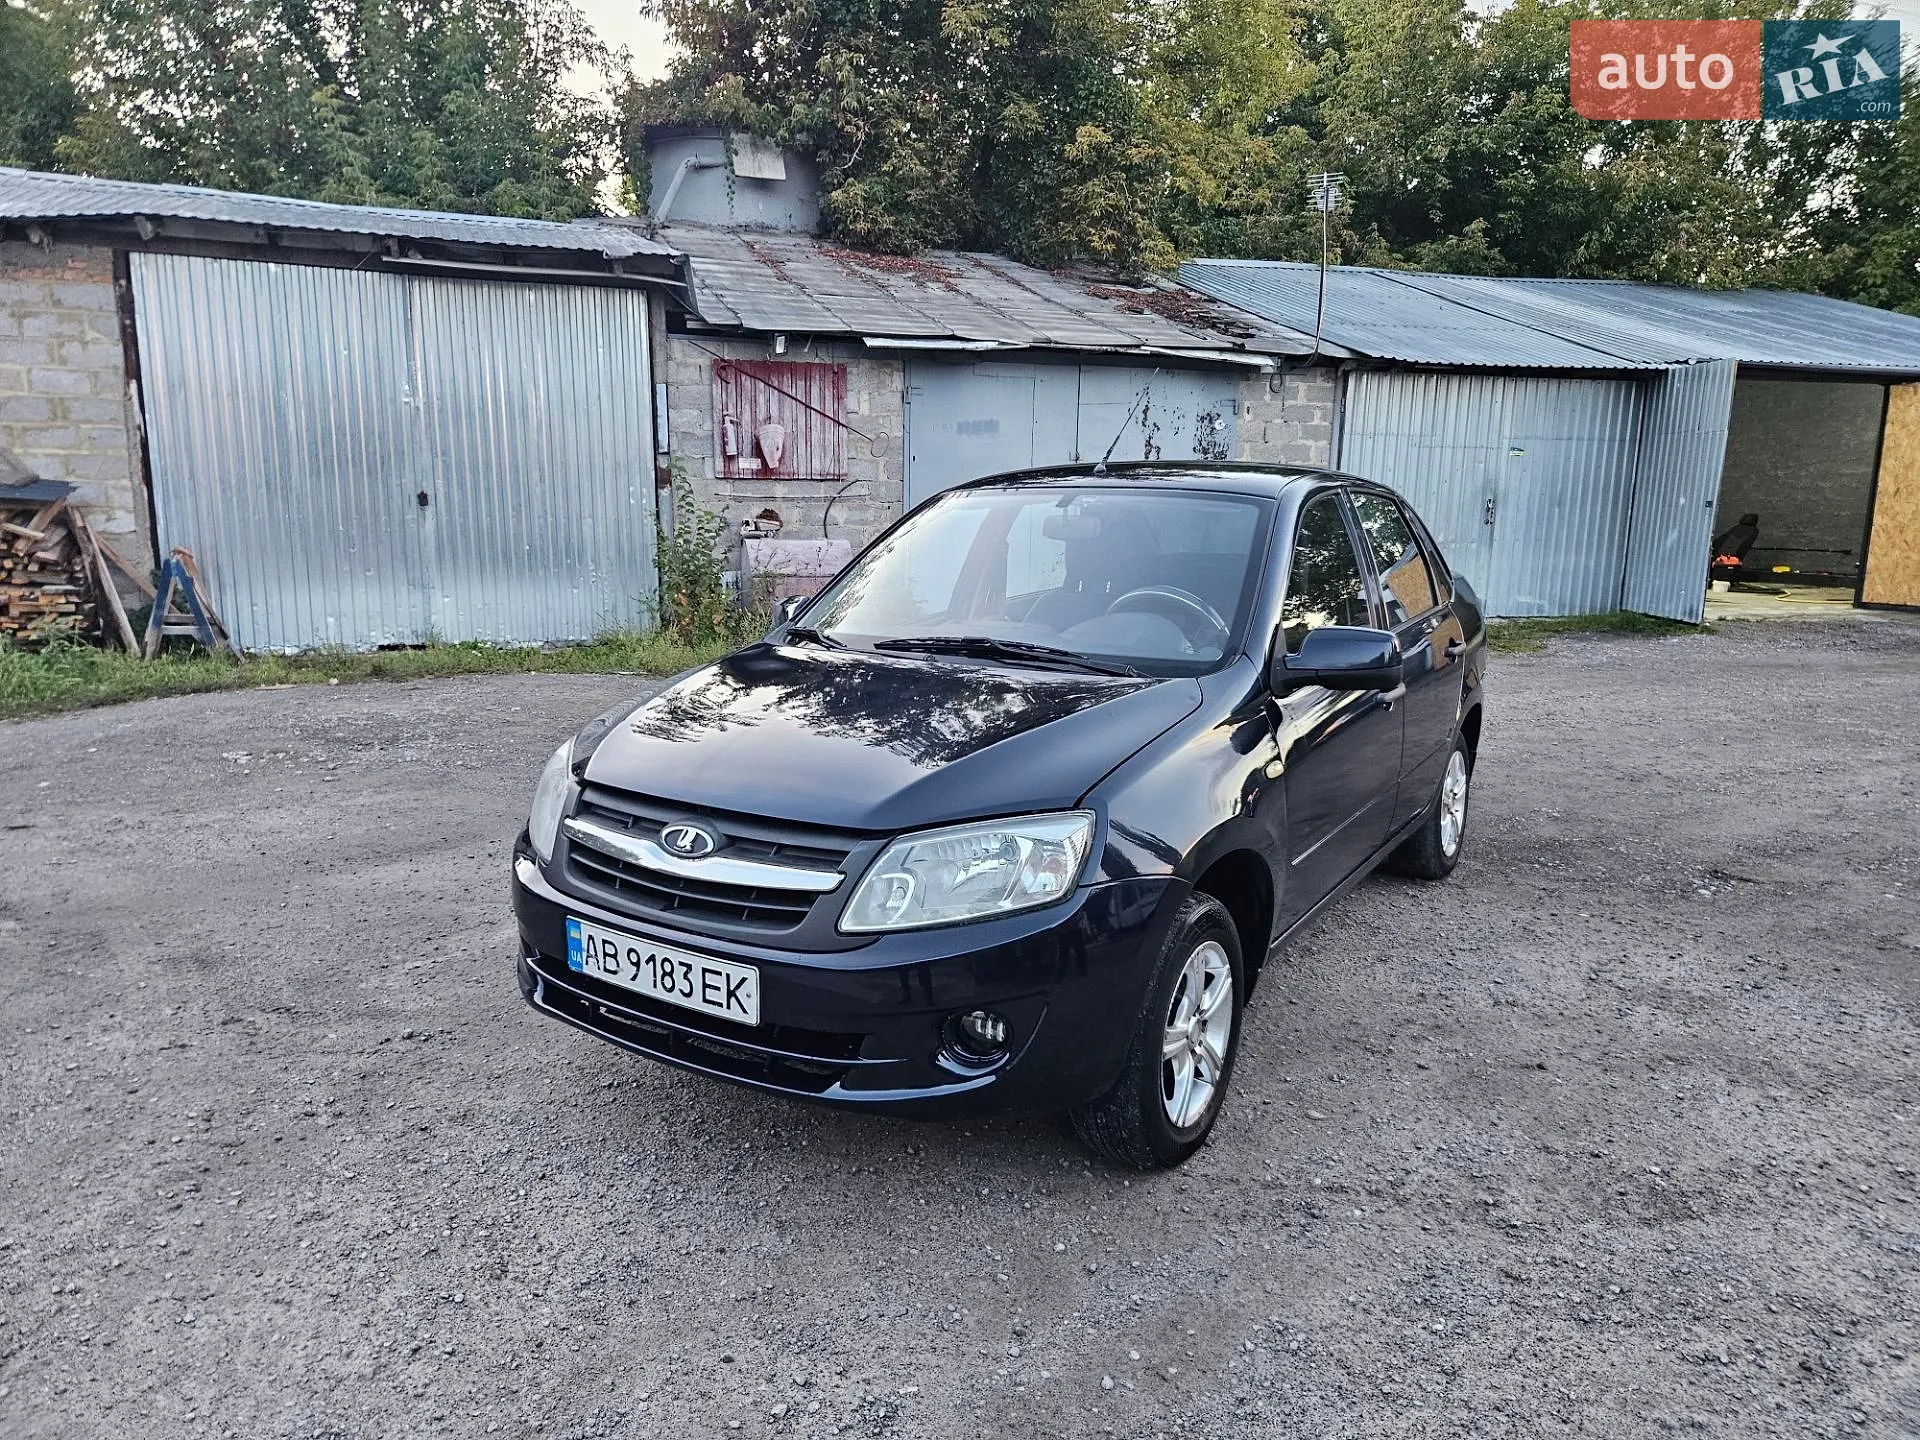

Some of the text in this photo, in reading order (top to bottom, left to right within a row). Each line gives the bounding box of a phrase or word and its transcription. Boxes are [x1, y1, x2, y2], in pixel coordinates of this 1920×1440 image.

[571, 950, 582, 963] UA
[585, 934, 750, 1015] AB 9183 EK
